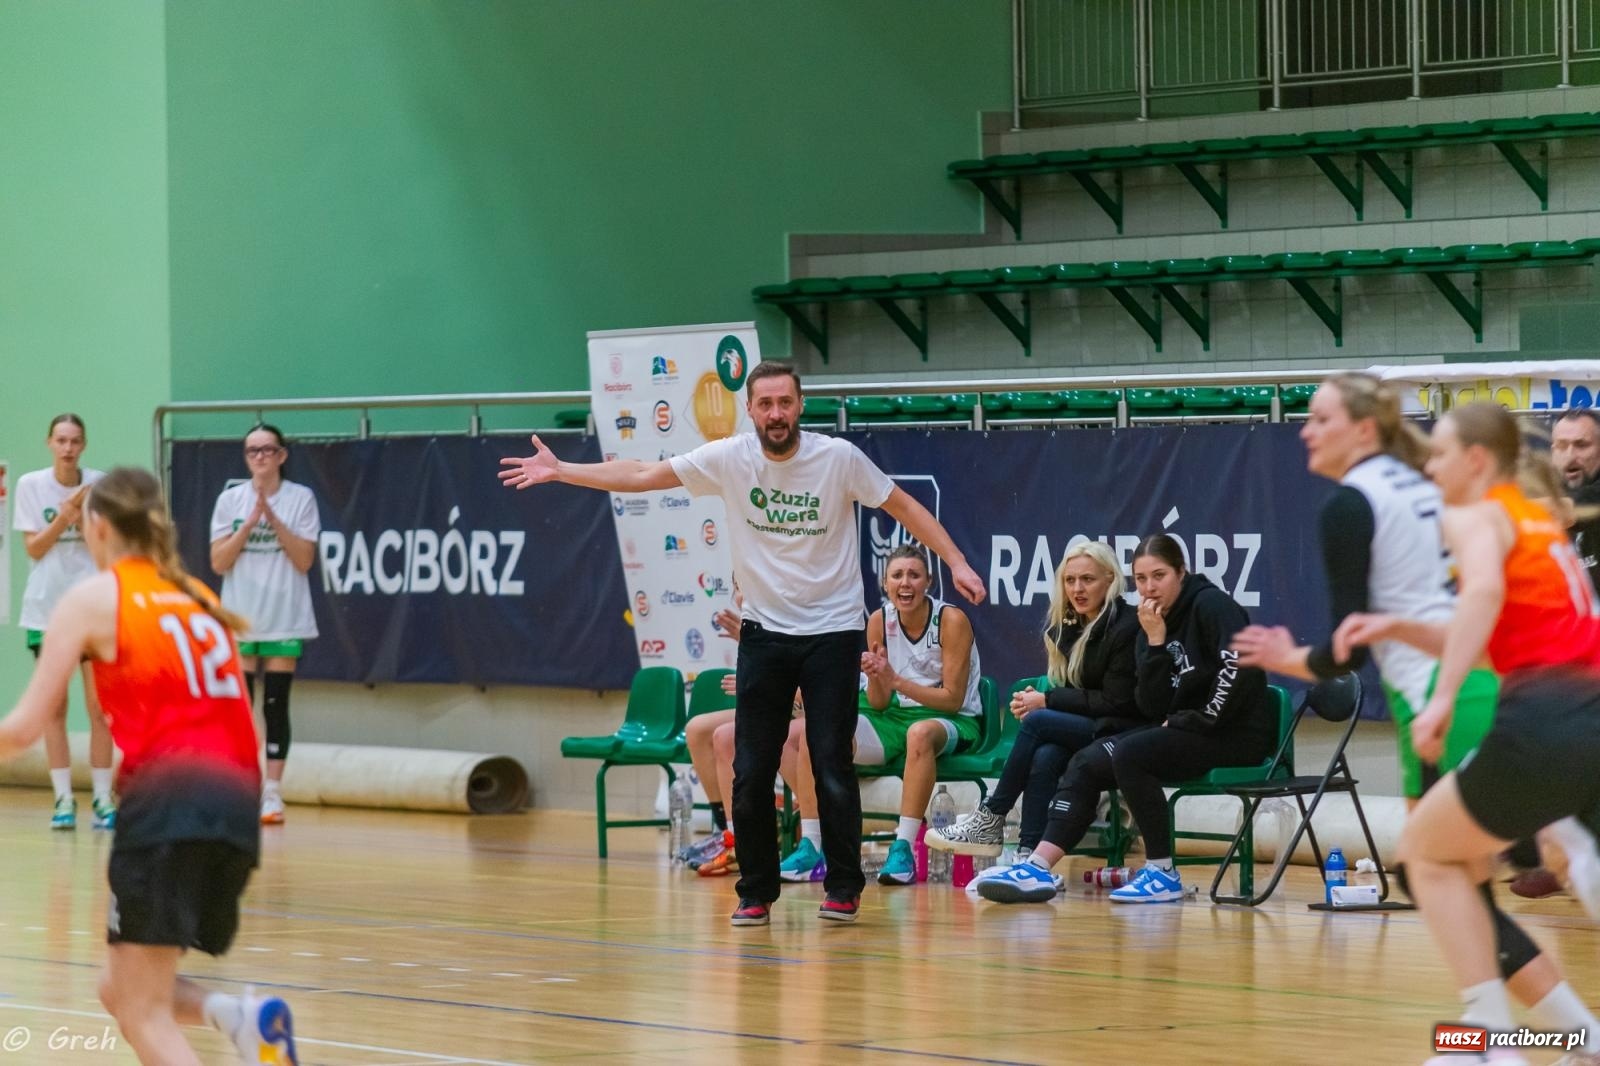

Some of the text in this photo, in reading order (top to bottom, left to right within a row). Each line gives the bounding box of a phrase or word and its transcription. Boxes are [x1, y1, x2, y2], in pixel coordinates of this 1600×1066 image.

[765, 508, 819, 523] Wera
[770, 488, 820, 508] Zuzia
[319, 504, 526, 596] RACIBÓRZ
[989, 505, 1262, 607] RABRZ
[159, 613, 241, 699] 12
[1203, 649, 1239, 717] ZUZANKA
